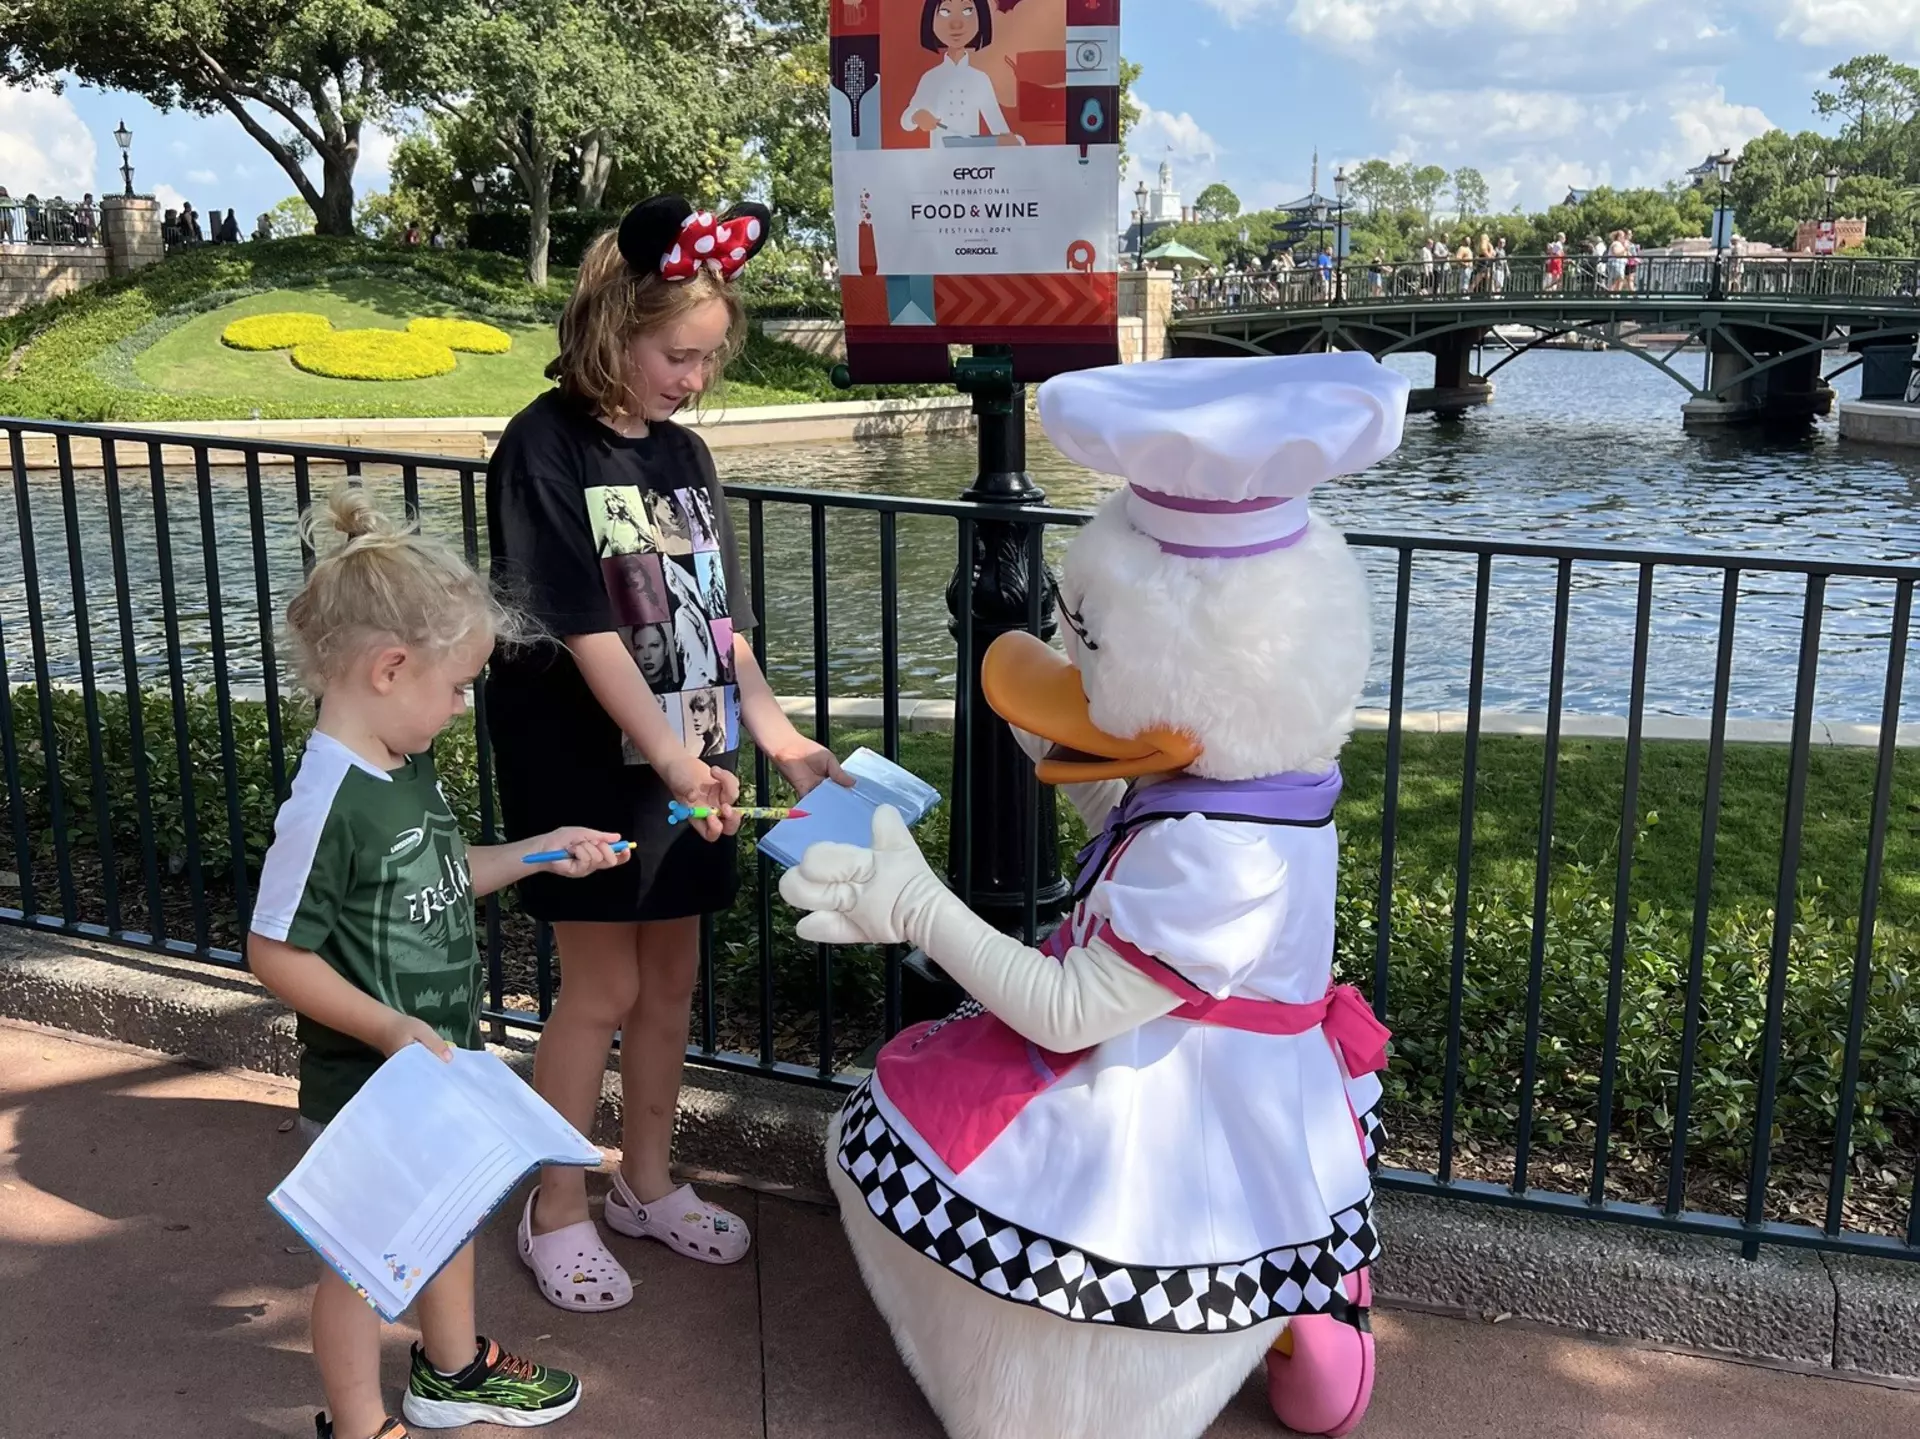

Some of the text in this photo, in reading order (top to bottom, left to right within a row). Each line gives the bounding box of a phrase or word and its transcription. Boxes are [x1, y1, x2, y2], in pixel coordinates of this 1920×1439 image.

[953, 167, 995, 180] EPCOT
[939, 188, 1010, 196] INTERNATIONAL
[911, 202, 1039, 220] FOOD & WINE
